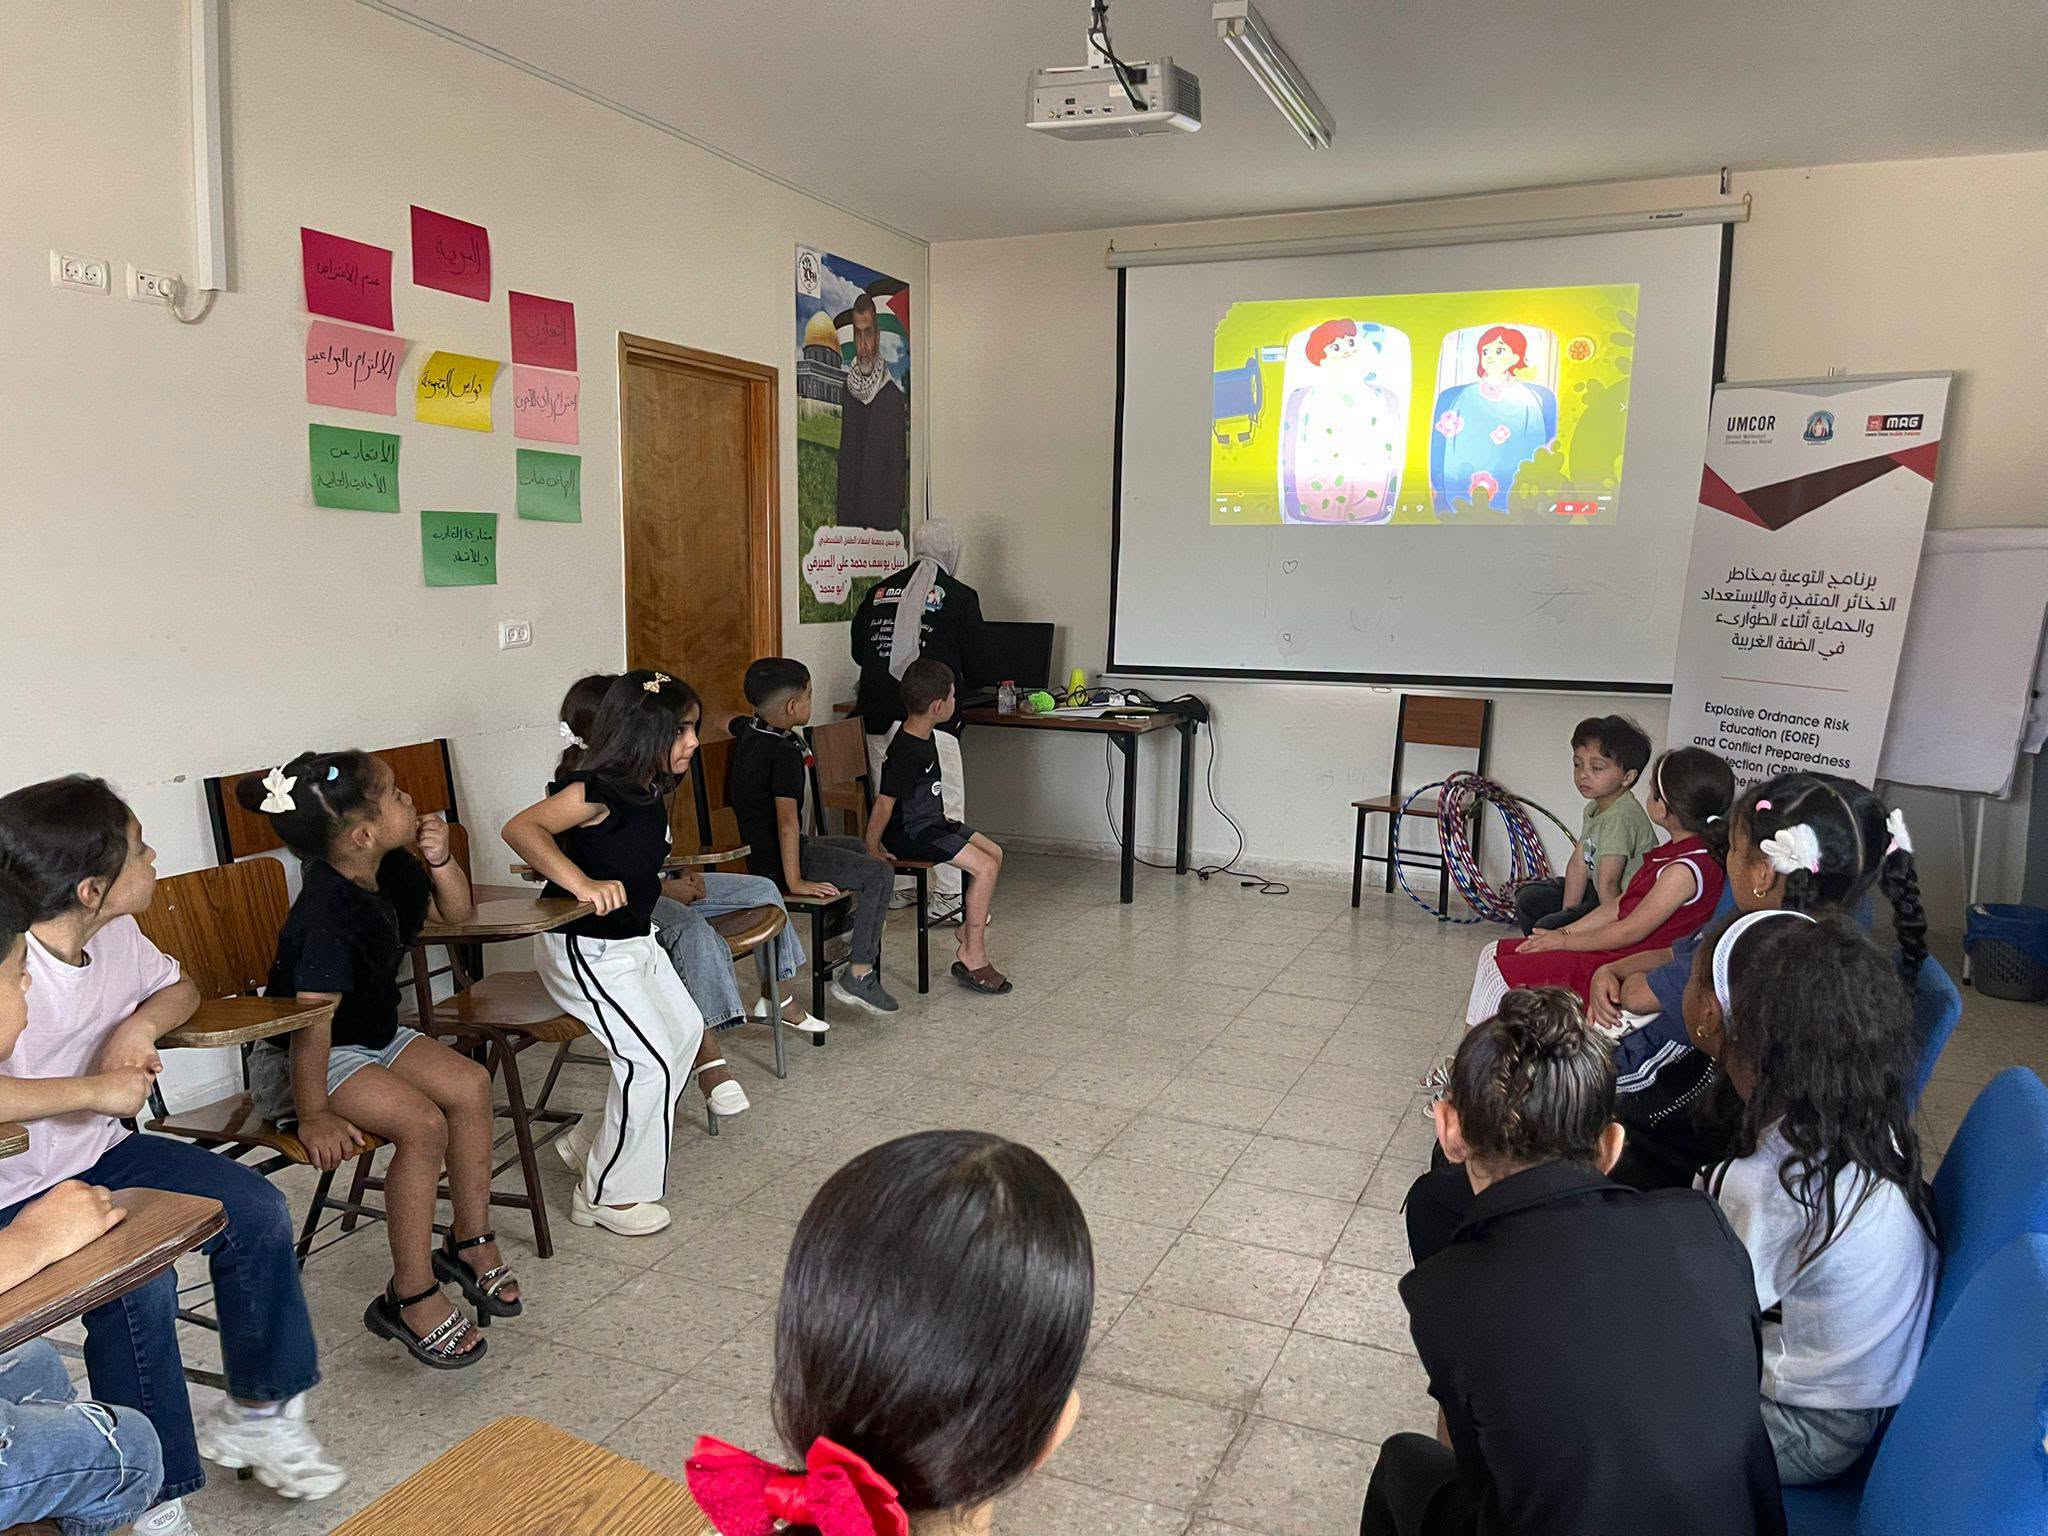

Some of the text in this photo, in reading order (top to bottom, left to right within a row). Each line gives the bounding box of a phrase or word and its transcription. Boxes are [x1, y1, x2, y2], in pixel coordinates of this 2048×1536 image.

[354, 349, 394, 390] الالتزام
[1727, 415, 1775, 431] UMCOR
[1886, 416, 1919, 428] MAG
[836, 554, 849, 574] علي
[850, 557, 868, 568] محمد
[869, 556, 890, 571] يوسف
[891, 555, 905, 571] نبيل
[1725, 566, 1877, 590] برنامج التوعية بمخاطر
[1779, 591, 1840, 610] المتفجرة
[1842, 594, 1897, 612] الذخائر
[1779, 609, 1811, 629] أثناء
[1812, 616, 1875, 637] والحماية
[1731, 632, 1846, 661] في الضفة الغربية
[1704, 701, 1850, 732] Explosive Ordnance Risk
[1719, 720, 1820, 748] Education (EORE)
[1693, 735, 1851, 769] and Conflict Preparedness
